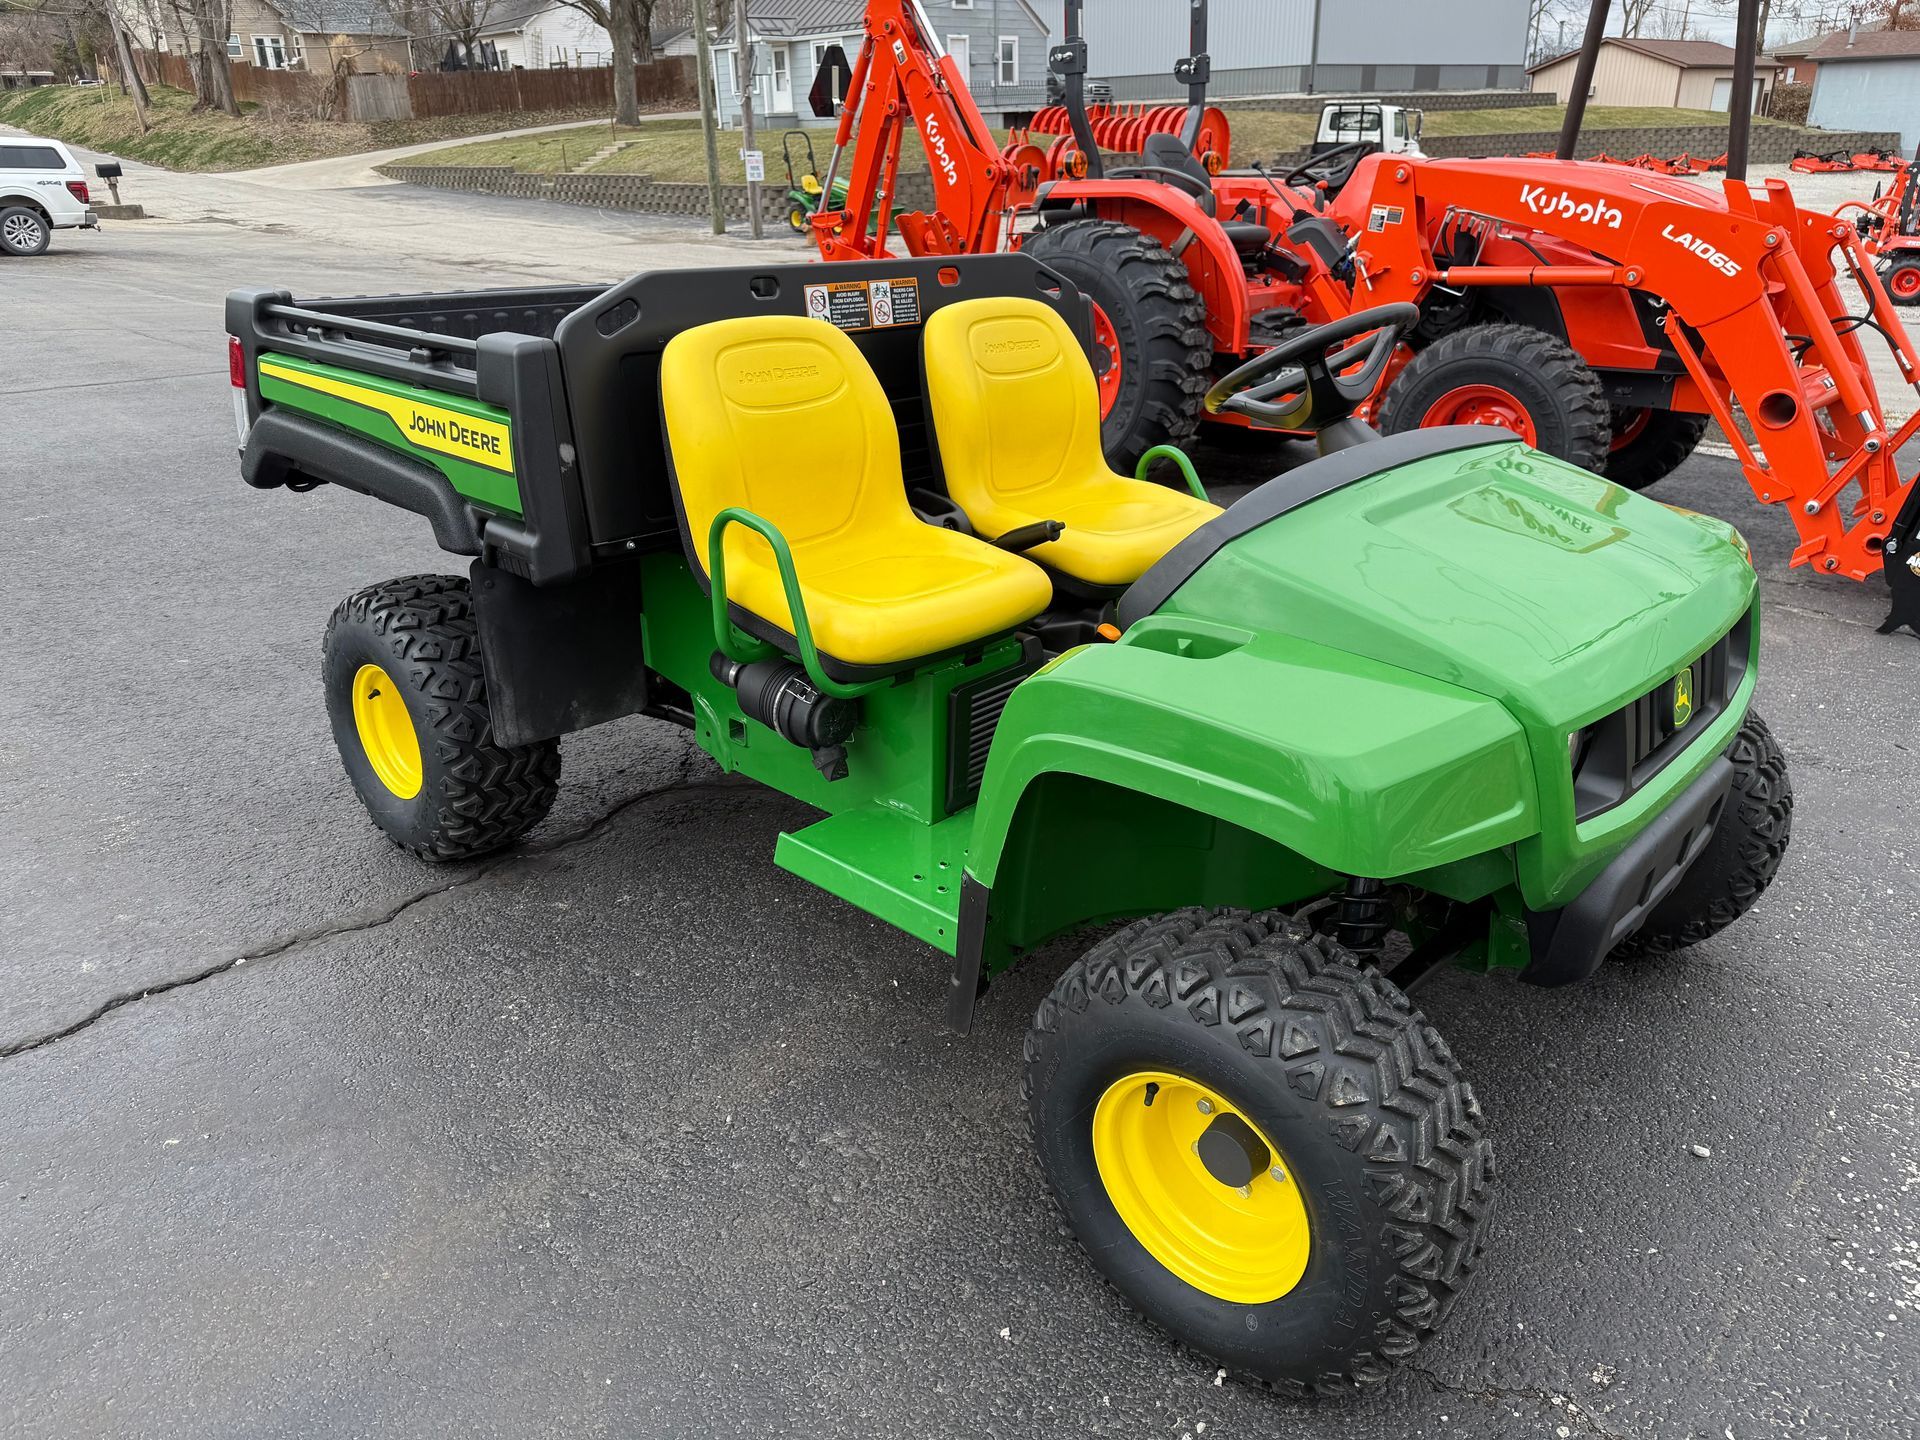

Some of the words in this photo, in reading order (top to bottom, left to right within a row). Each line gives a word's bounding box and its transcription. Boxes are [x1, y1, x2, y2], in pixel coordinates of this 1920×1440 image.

[925, 113, 957, 186] Kubota
[1519, 184, 1623, 229] Kubota
[1661, 224, 1742, 277] LA1065
[409, 410, 447, 440] JOHN
[449, 421, 501, 456] DEERE
